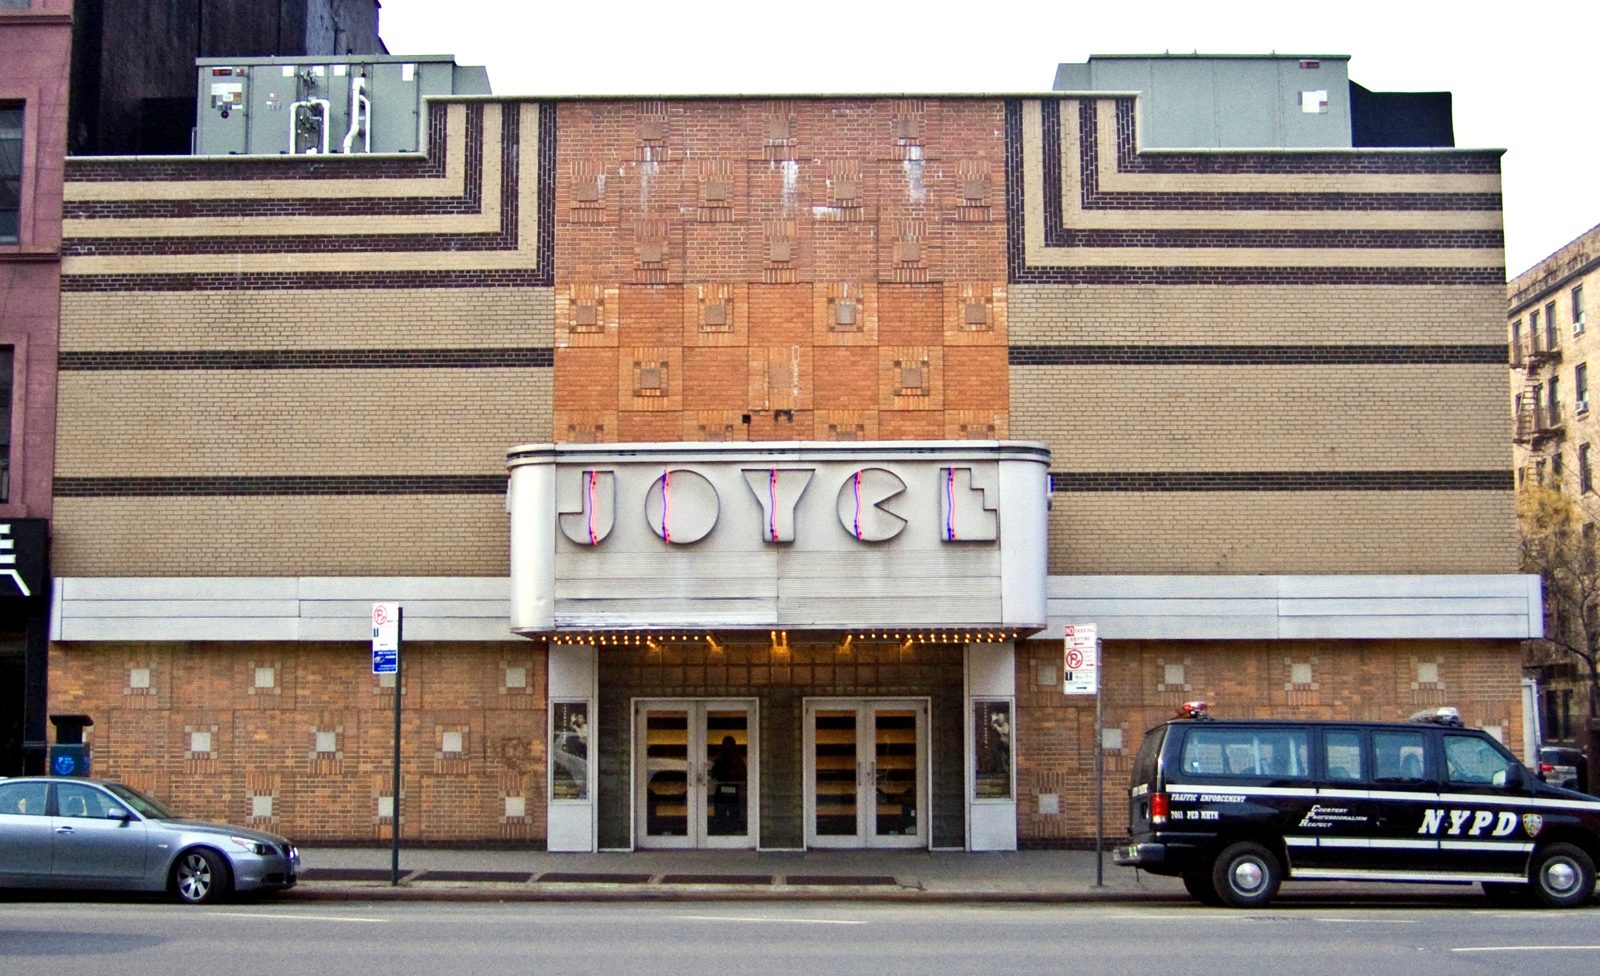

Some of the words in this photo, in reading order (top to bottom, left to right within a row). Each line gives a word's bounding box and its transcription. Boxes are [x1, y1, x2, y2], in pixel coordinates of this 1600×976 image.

[558, 466, 998, 544] JOYCE
[1171, 793, 1198, 802] TRAFFIC
[1200, 794, 1247, 804] ENFORCEMENT
[1417, 809, 1517, 836] NYPD
